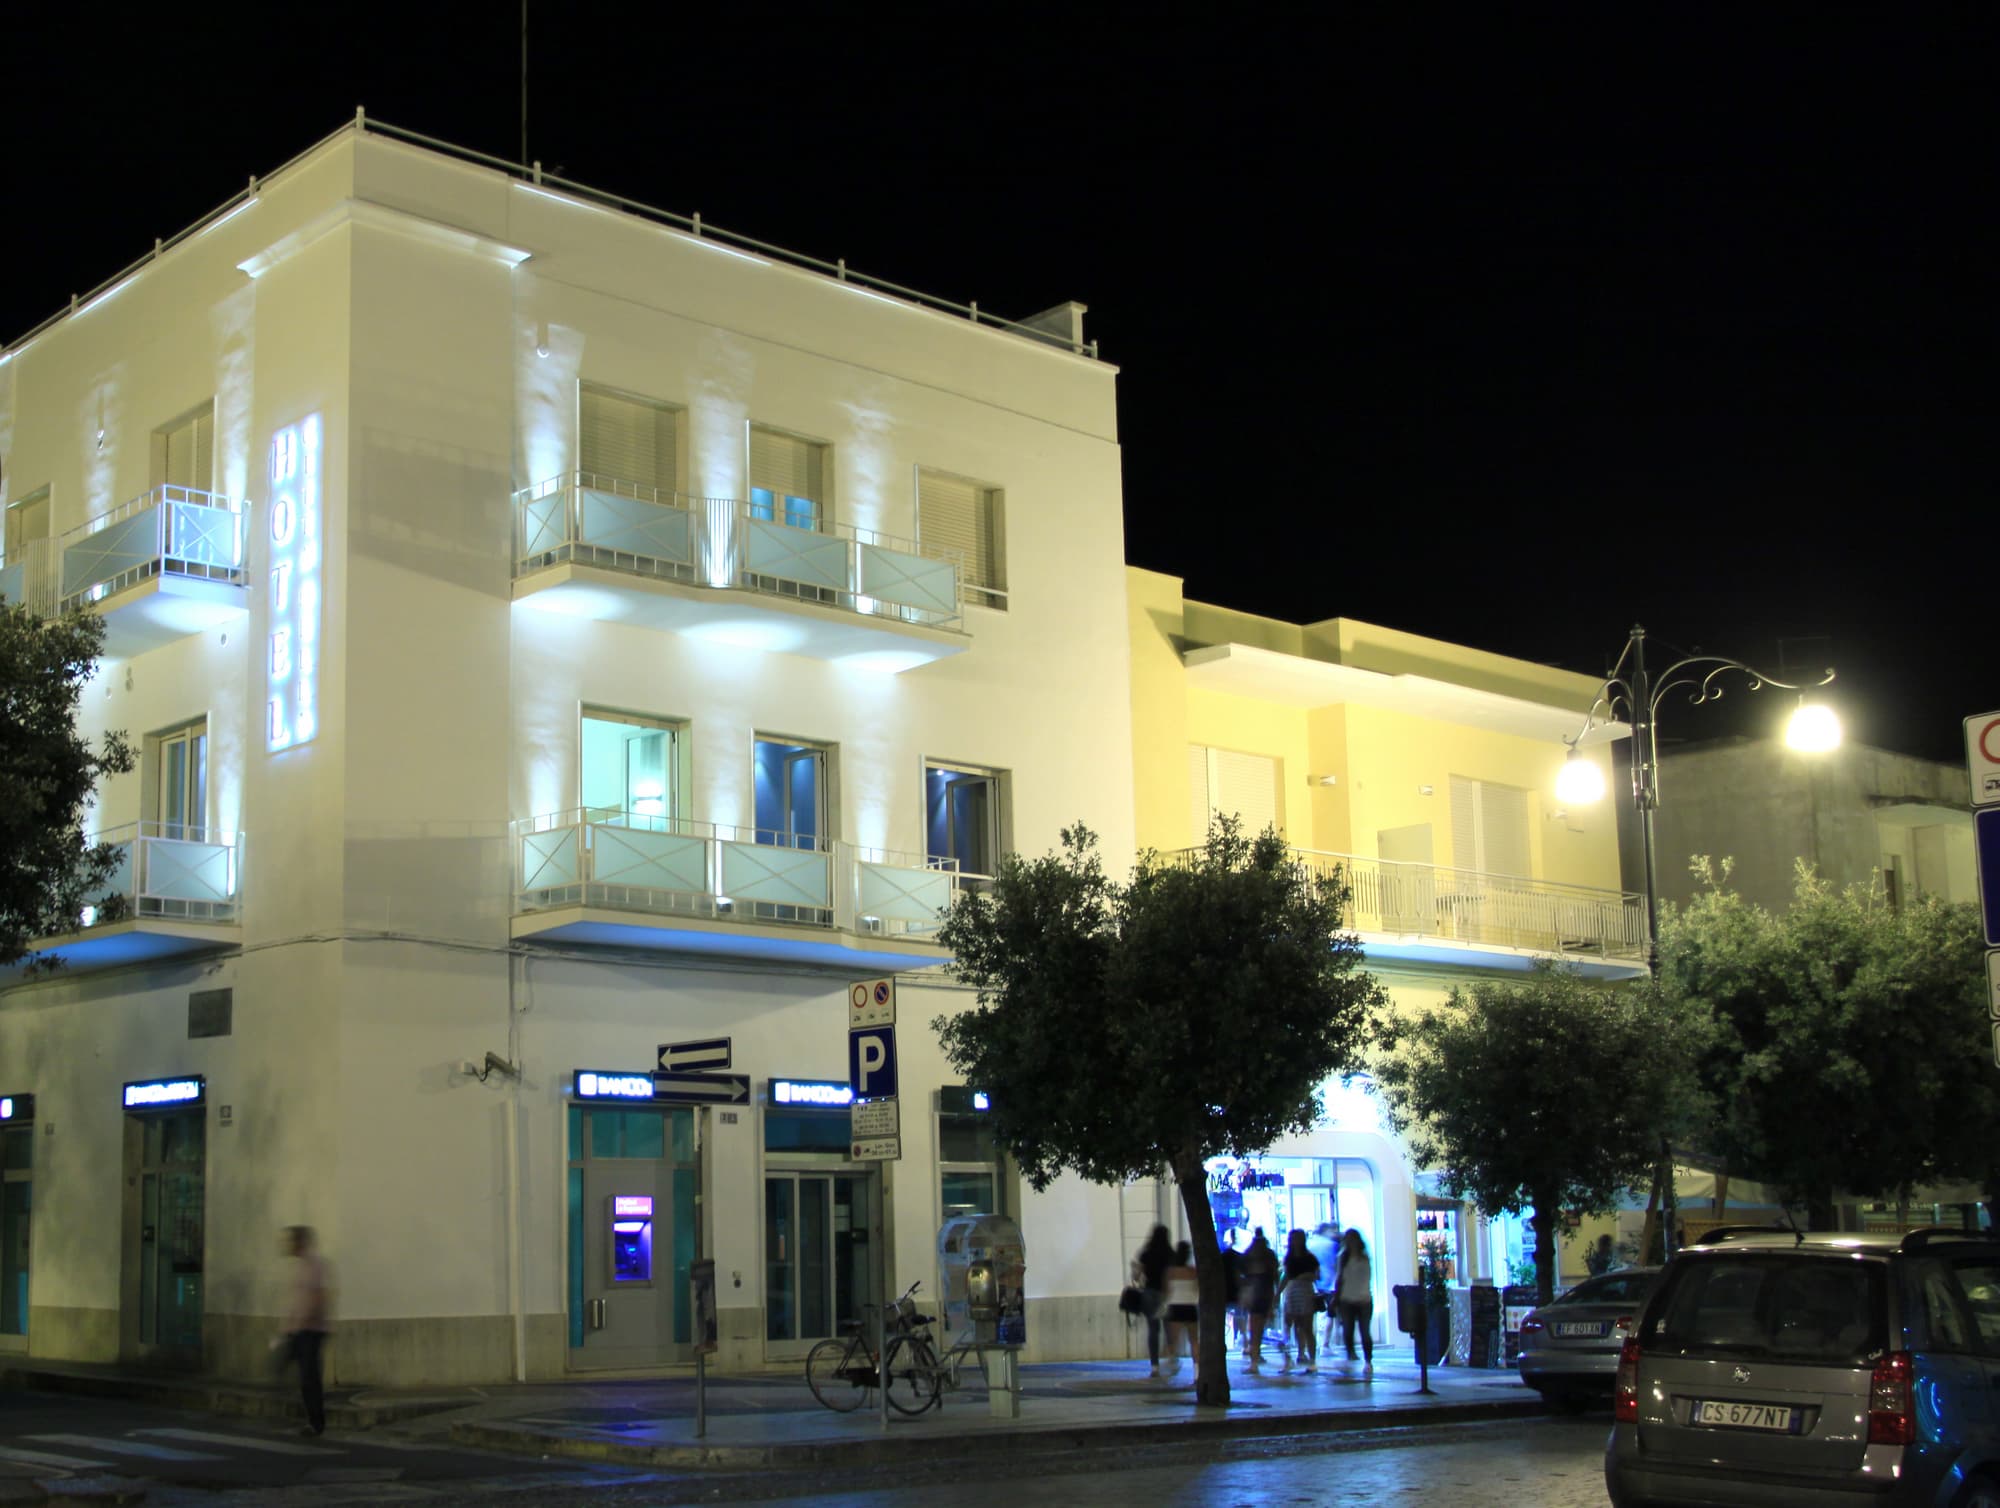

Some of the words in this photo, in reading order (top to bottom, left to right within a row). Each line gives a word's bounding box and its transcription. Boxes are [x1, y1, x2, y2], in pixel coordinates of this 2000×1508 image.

[270, 433, 296, 747] HOTEL
[858, 1035, 887, 1093] P
[1702, 1403, 1725, 1422] CS
[1729, 1404, 1790, 1428] 677NT
